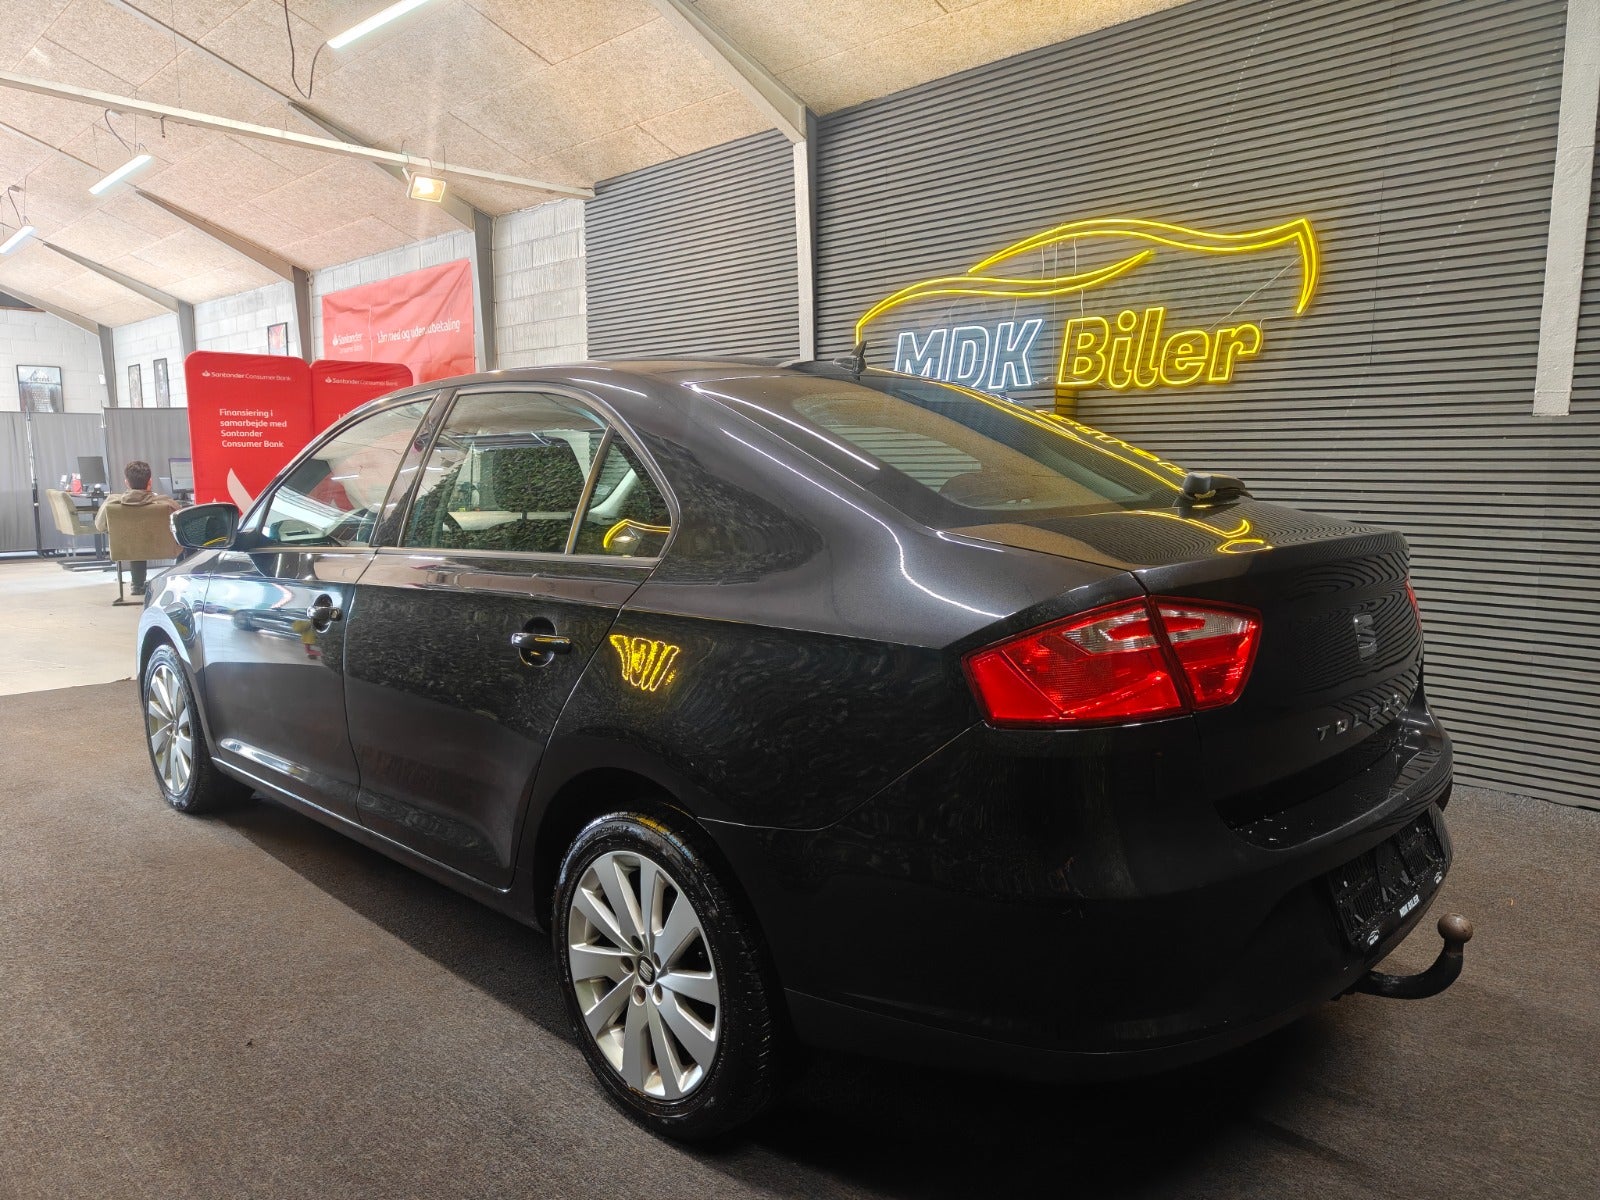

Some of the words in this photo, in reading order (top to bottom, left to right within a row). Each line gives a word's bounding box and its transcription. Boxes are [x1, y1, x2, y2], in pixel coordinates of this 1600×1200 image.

[401, 330, 411, 341] og
[425, 318, 460, 334] dbetaling
[893, 318, 1043, 390] MDK
[1056, 306, 1262, 390] Biler
[211, 371, 245, 379] Santander
[219, 408, 269, 418] Finansiering
[270, 409, 274, 417] i
[220, 420, 268, 428] samarbejde
[269, 420, 287, 428] med
[220, 430, 263, 438] Santander
[221, 440, 263, 448] Consumer
[263, 440, 285, 448] Bank
